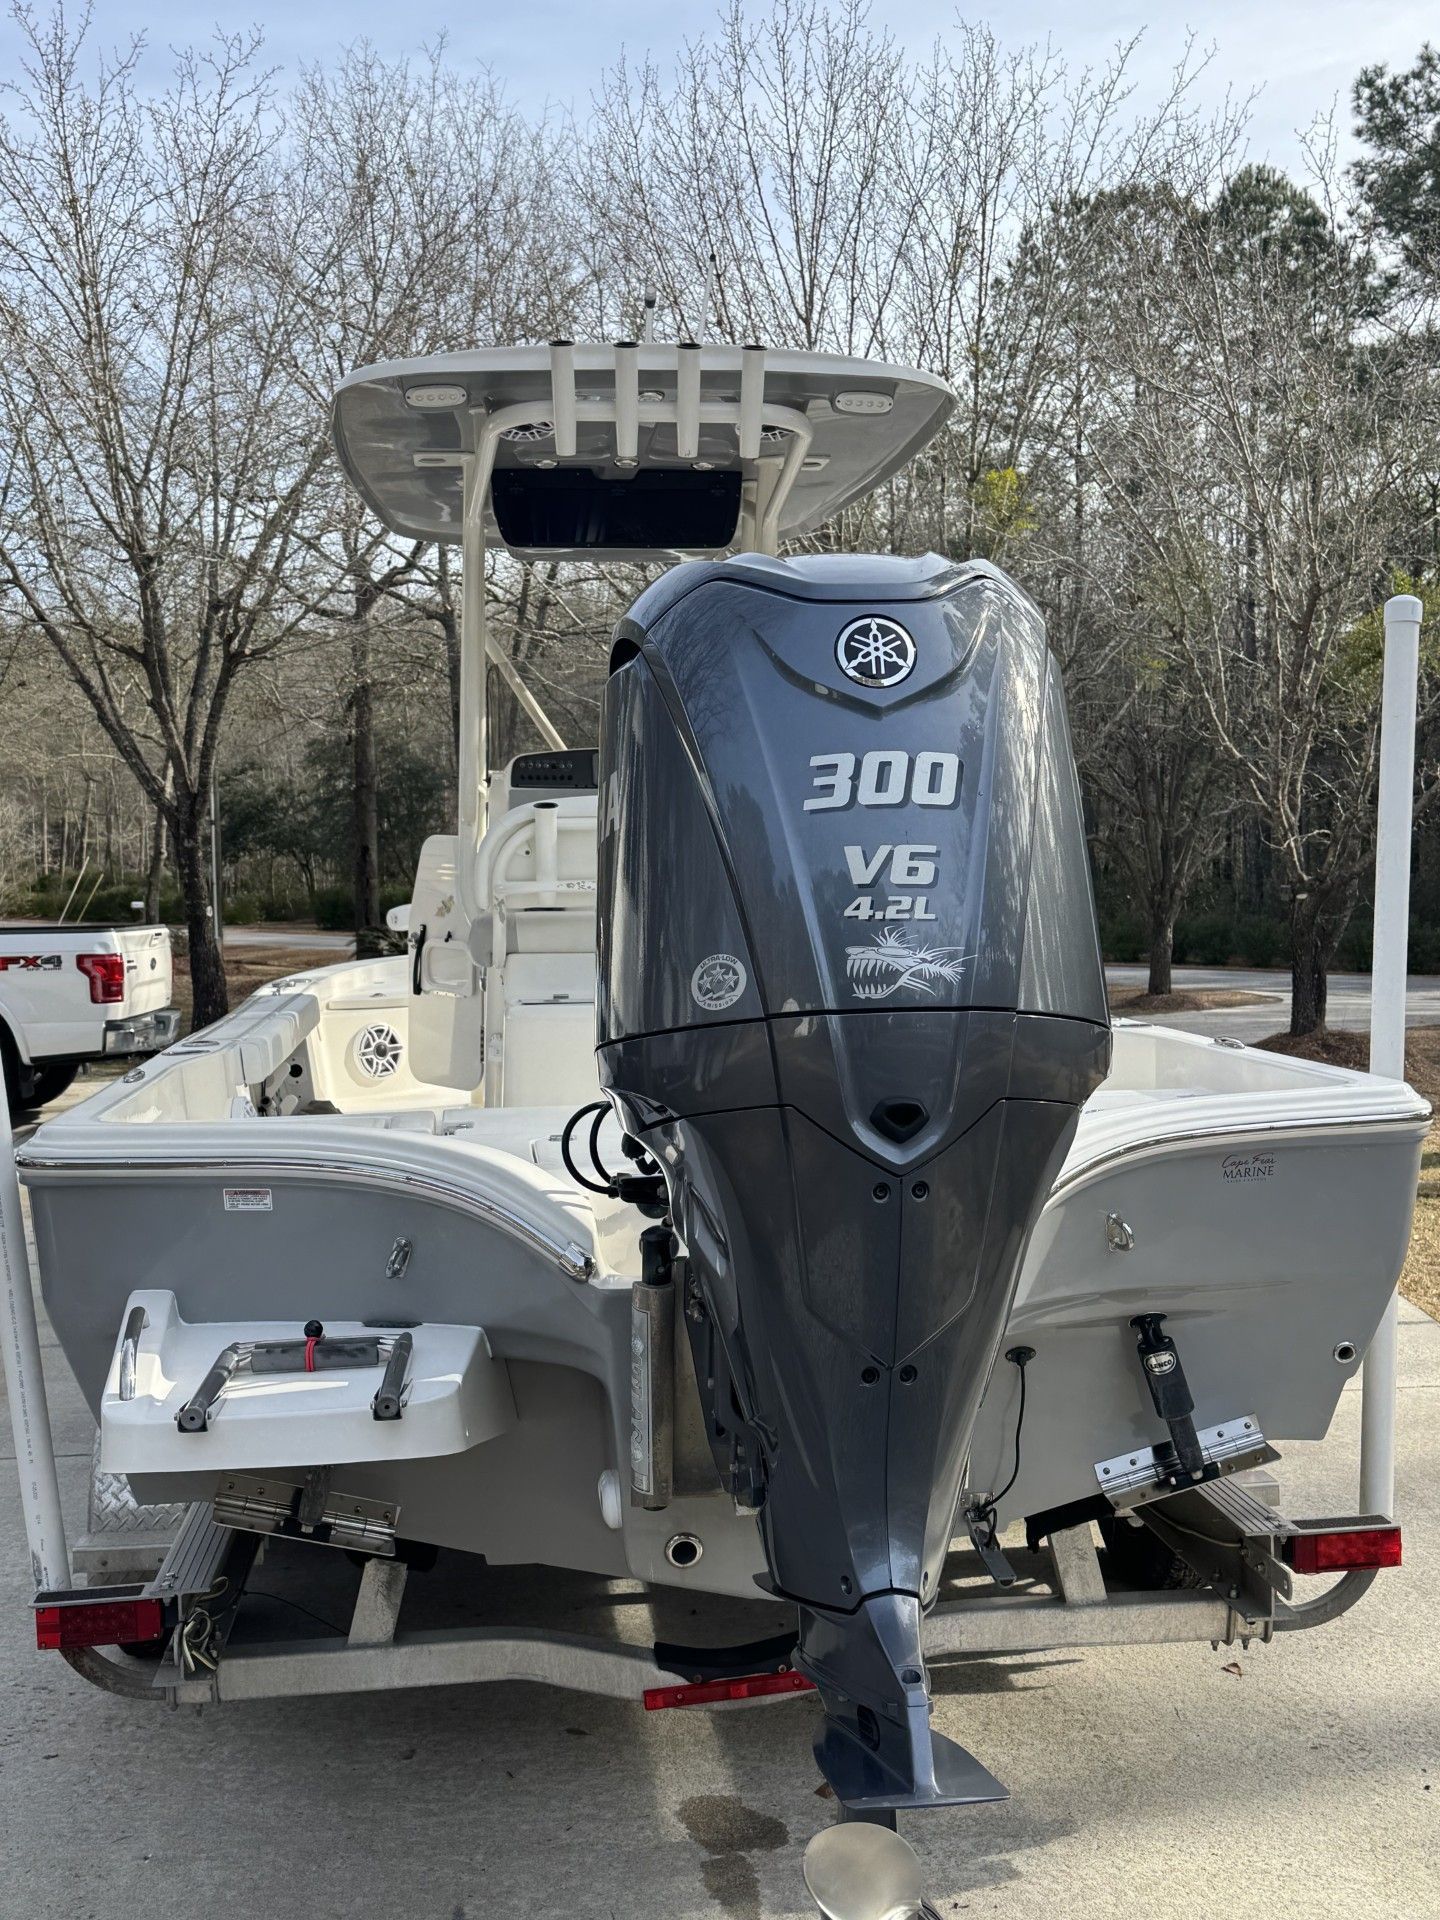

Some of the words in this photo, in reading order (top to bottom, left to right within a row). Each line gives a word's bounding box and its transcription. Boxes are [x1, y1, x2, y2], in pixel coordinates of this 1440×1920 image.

[803, 750, 962, 811] 300
[844, 844, 939, 887] V6
[844, 895, 937, 921] 4.2L
[0, 955, 62, 971] FX4
[1221, 1154, 1250, 1170] Cape
[1251, 1152, 1278, 1166] Fear
[1223, 1165, 1275, 1179] MARINE
[1150, 1359, 1173, 1370] LENCO
